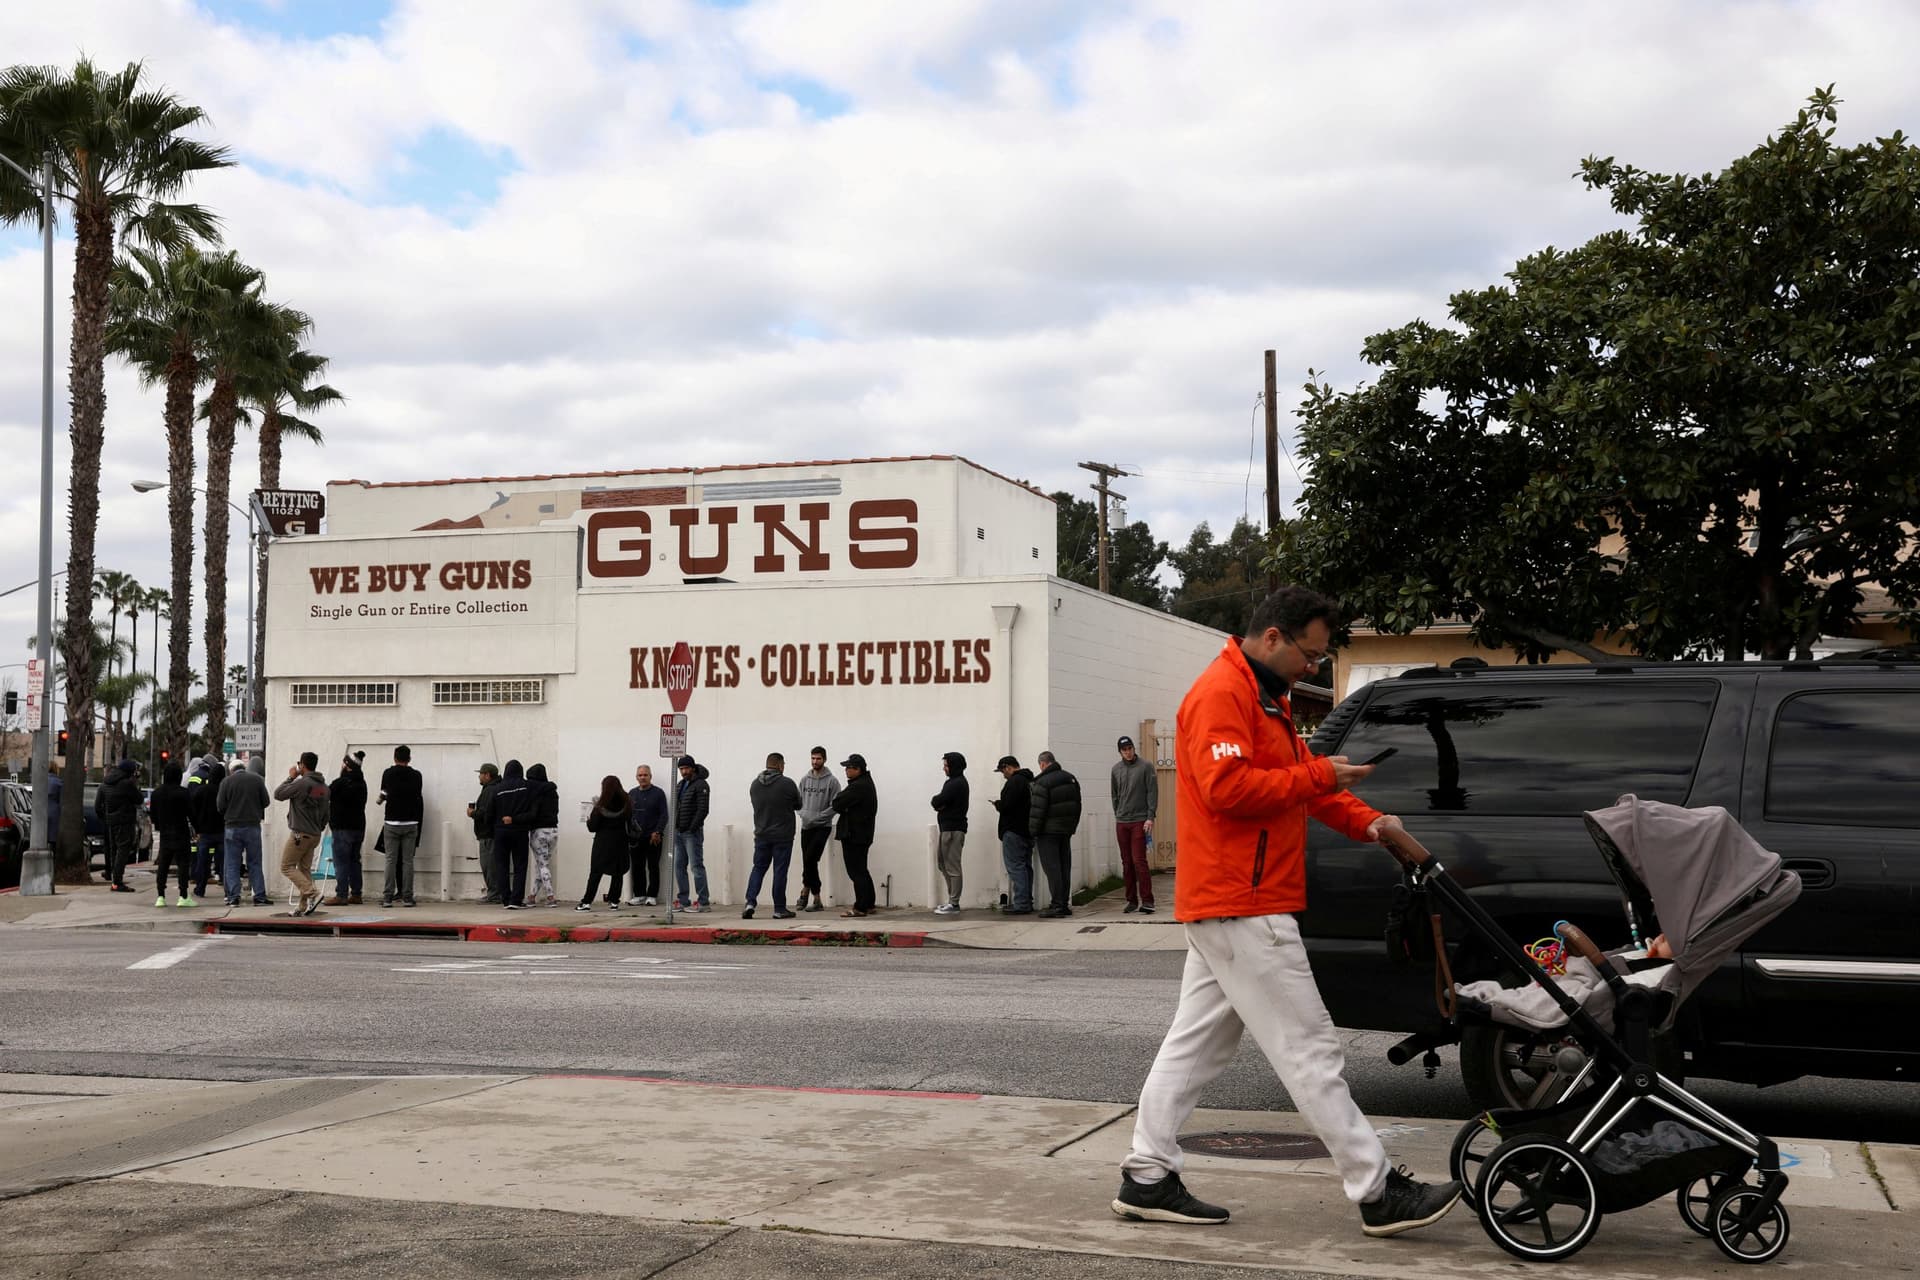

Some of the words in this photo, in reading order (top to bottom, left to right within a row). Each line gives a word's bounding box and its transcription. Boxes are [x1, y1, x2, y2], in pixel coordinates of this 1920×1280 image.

[262, 492, 319, 509] RETTING
[272, 508, 301, 516] 11029
[587, 499, 918, 578] GUNS
[309, 566, 360, 594] WE
[367, 563, 431, 593] BUY
[439, 559, 532, 591] GUNS
[310, 605, 352, 620] Single
[358, 604, 387, 616] Gun
[391, 606, 405, 616] or
[409, 602, 451, 615] Entire
[456, 600, 529, 614] Collection
[629, 645, 740, 688] KNVES
[761, 639, 991, 687] COLLECTIBLES
[669, 664, 692, 690] STOP
[662, 716, 672, 726] NO
[1211, 742, 1241, 760] HH
